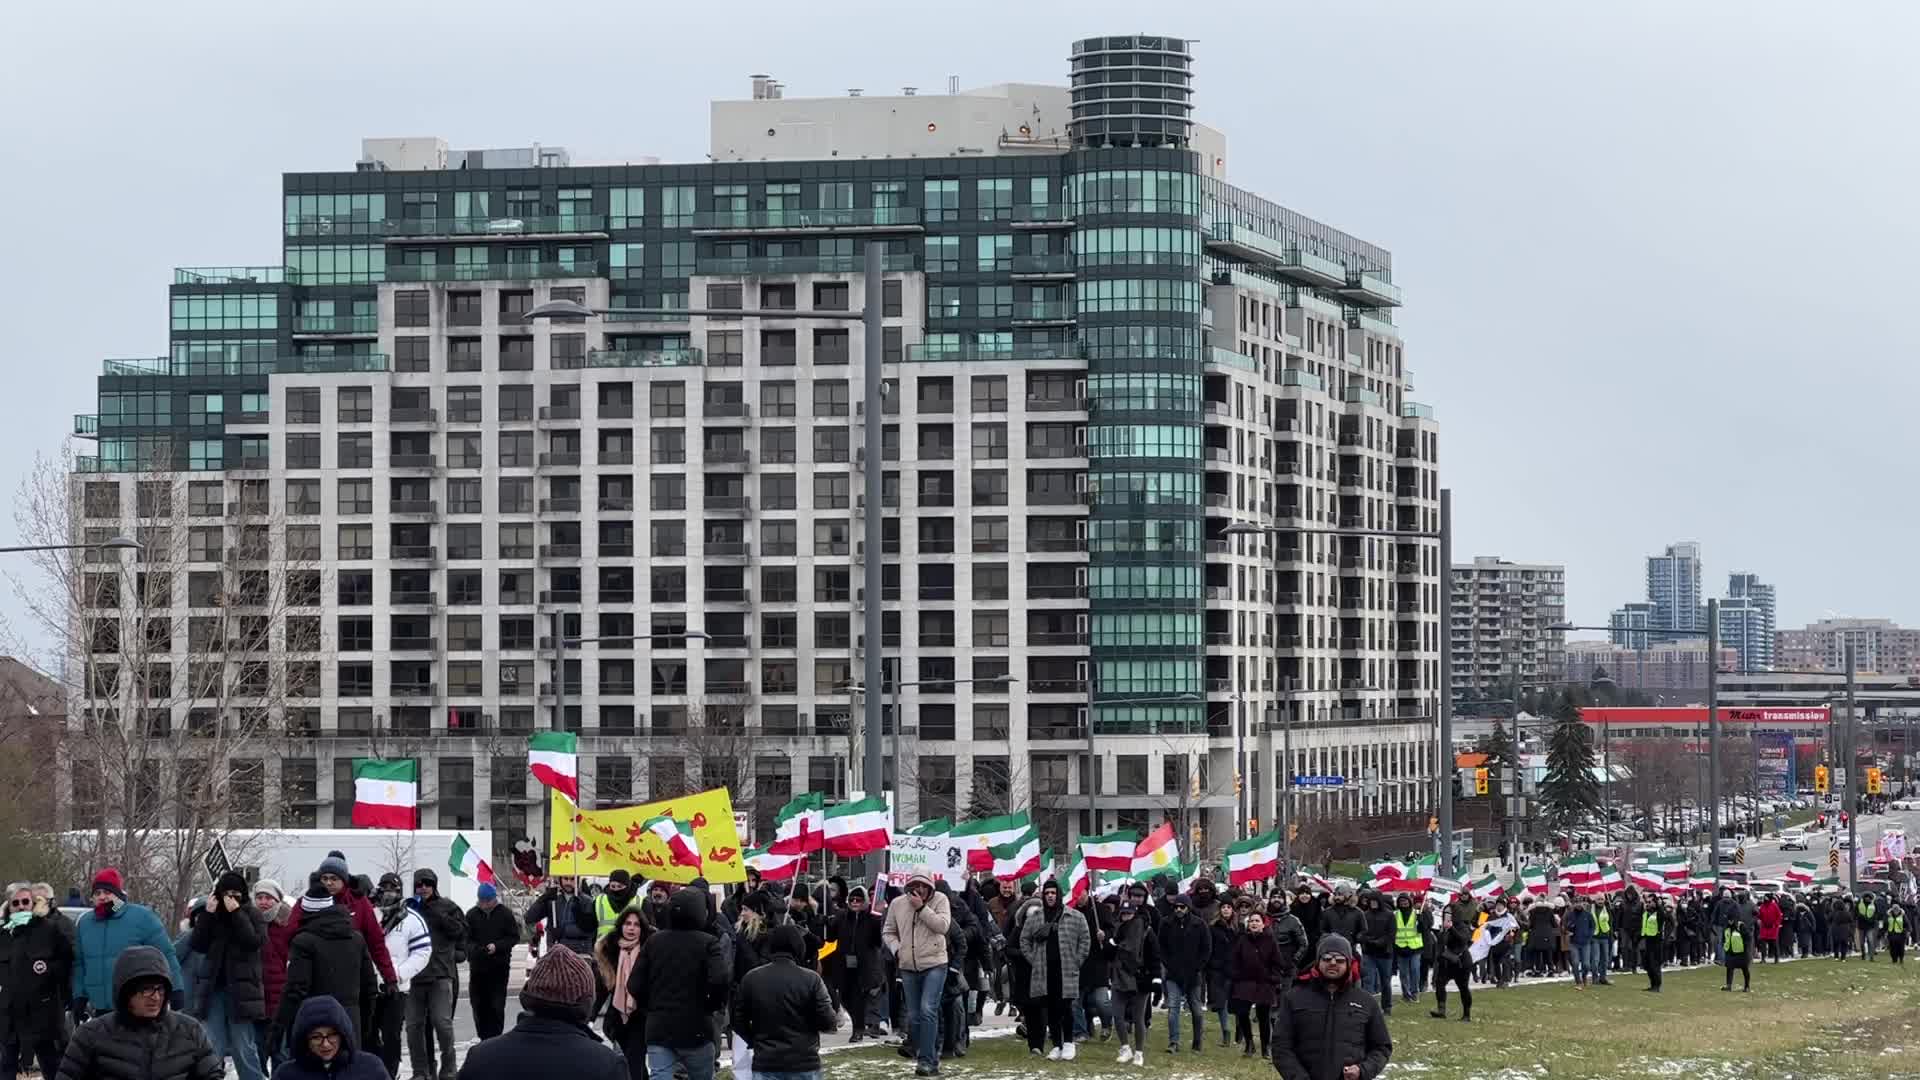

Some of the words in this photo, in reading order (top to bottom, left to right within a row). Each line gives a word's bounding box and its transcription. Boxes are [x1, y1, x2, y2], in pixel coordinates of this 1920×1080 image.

[1763, 711, 1825, 720] transmission
[551, 836, 599, 861] رهبر
[708, 846, 737, 869] چه
[891, 852, 927, 864] WOMAN
